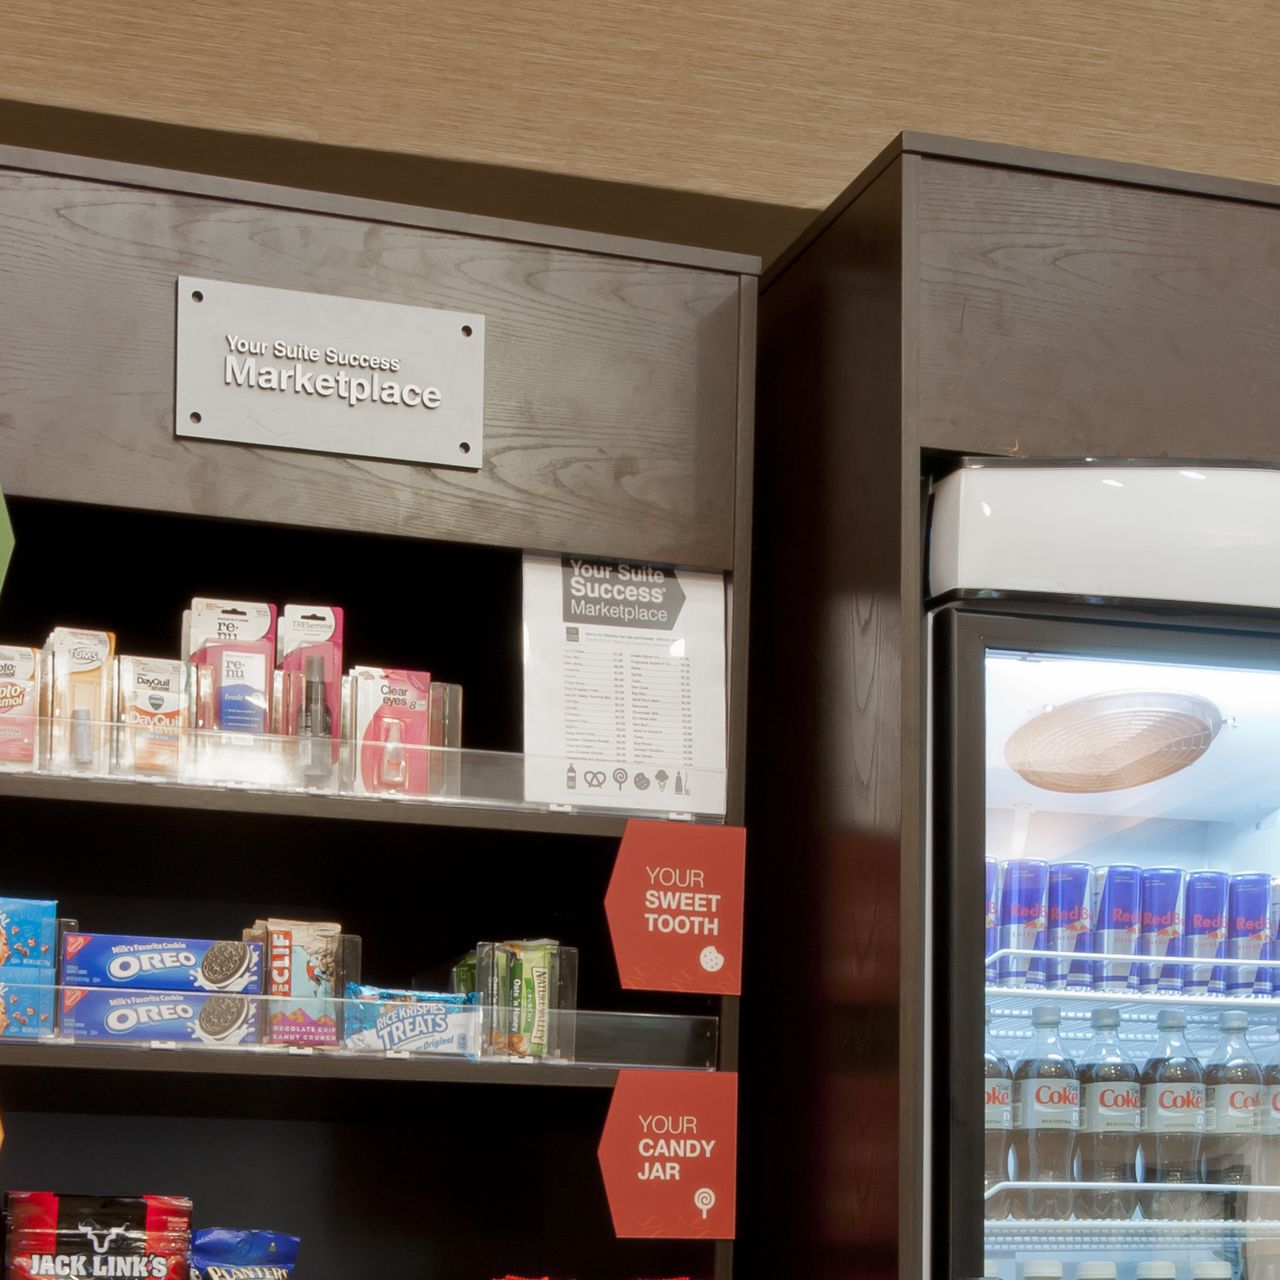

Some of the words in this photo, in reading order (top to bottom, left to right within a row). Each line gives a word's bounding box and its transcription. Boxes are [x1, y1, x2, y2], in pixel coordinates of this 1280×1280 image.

[226, 334, 268, 356] Your
[273, 340, 320, 362] Suite
[325, 347, 401, 372] Success
[224, 355, 443, 409] Marketplace
[570, 559, 612, 578] Your
[618, 564, 665, 583] Suite
[570, 599, 668, 622] Marketplace
[69, 650, 98, 662] TUMS
[136, 676, 170, 689] DayQuil
[380, 684, 408, 697] Clear
[382, 697, 408, 707] eyes
[645, 866, 705, 888] YOUR
[645, 890, 721, 913] SWEET
[644, 913, 719, 936] TOOTH
[108, 951, 196, 979] OREO
[272, 934, 290, 981] CLIF
[513, 978, 521, 997] Oats
[106, 1004, 194, 1032] OREO
[376, 1012, 398, 1031] RICE
[398, 1003, 447, 1022] KRISPIES
[272, 1025, 316, 1033] HOCOLATE
[377, 1013, 448, 1050] TREATS
[423, 1035, 454, 1050] Original
[985, 1086, 1009, 1105] oke
[1035, 1085, 1079, 1105] Coke
[1099, 1088, 1140, 1109] Coke
[1158, 1089, 1203, 1109] Coke
[638, 1115, 697, 1134] YOUR
[638, 1138, 716, 1158] CANDY
[637, 1162, 680, 1180] JAR
[30, 1254, 87, 1276] JACK
[93, 1254, 168, 1278] LINK'S
